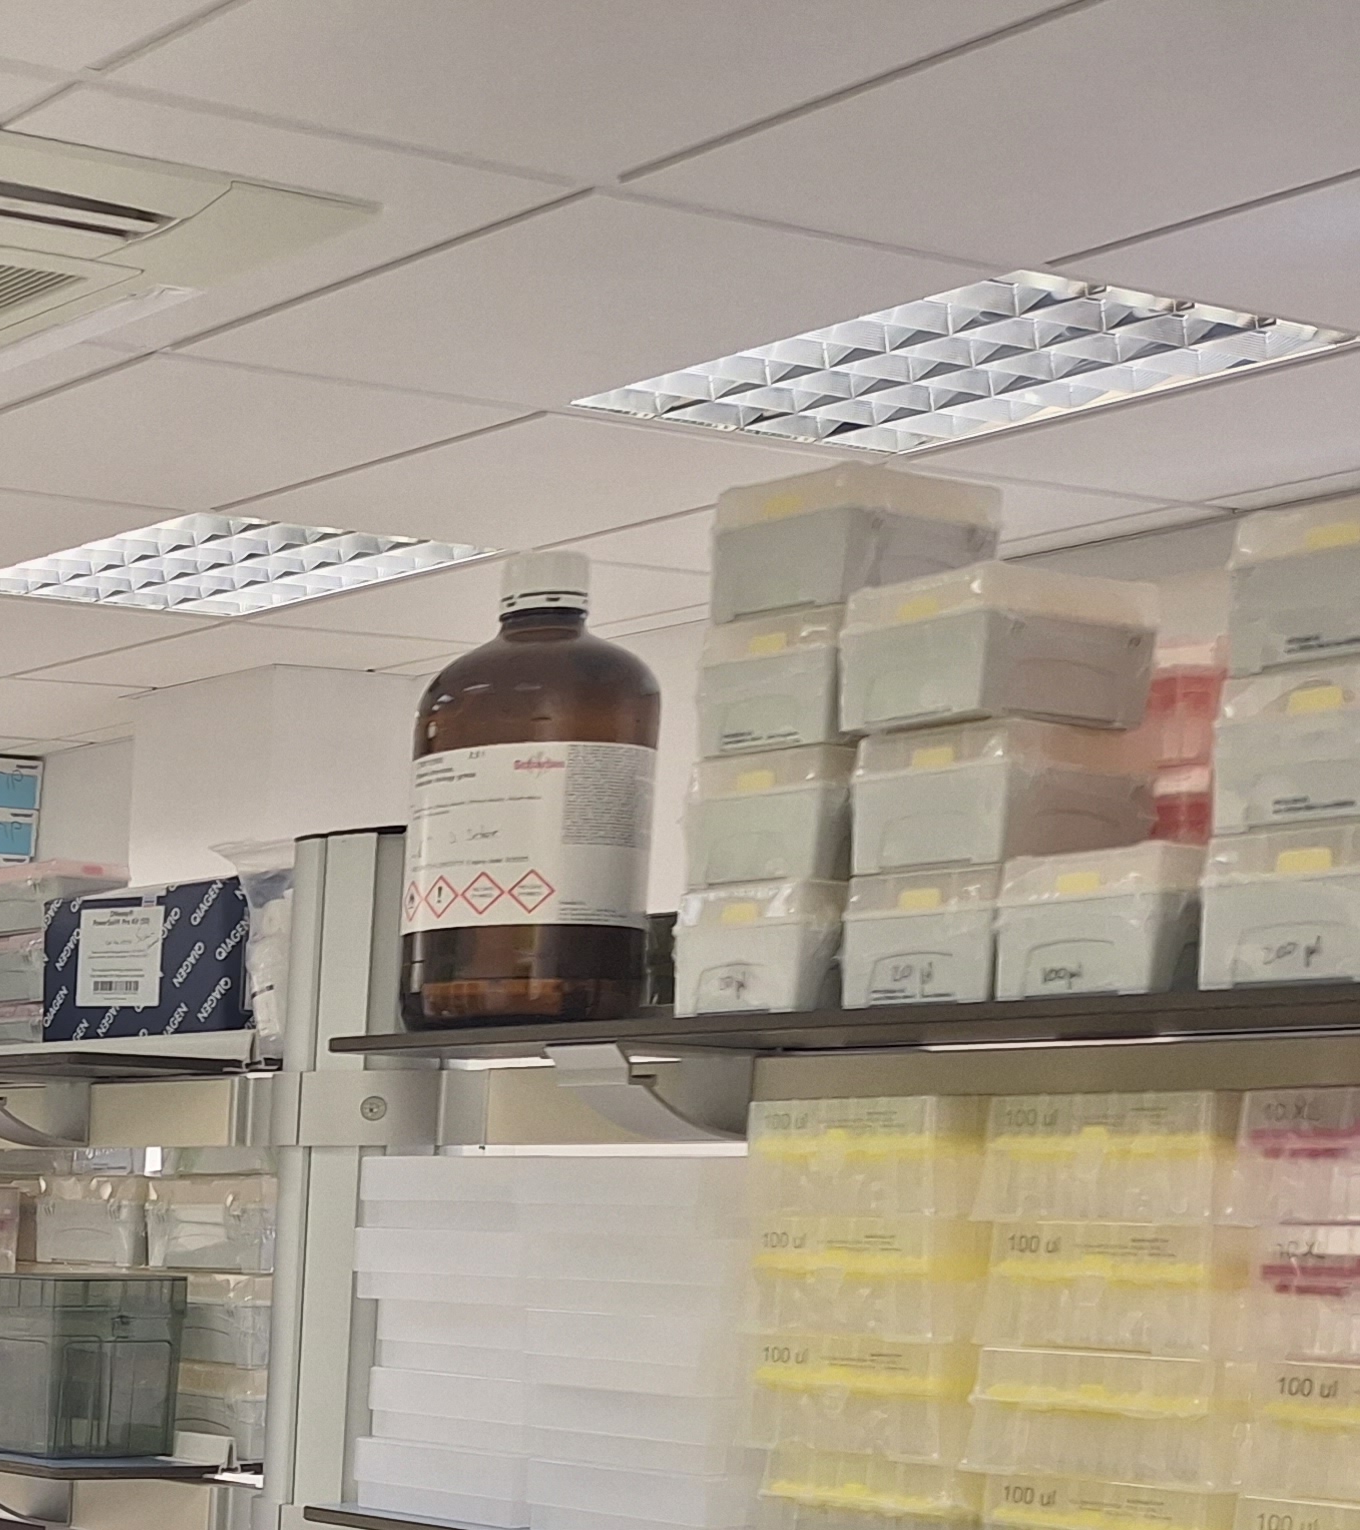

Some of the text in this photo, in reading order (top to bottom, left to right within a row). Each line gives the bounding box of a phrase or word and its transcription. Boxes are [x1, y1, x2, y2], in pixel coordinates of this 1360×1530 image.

[190, 880, 224, 926] QIAGEN
[172, 942, 205, 988] QIAGEN
[197, 977, 231, 1023] QIAGEN
[1277, 1377, 1313, 1397] 100
[1003, 1485, 1035, 1504] 100
